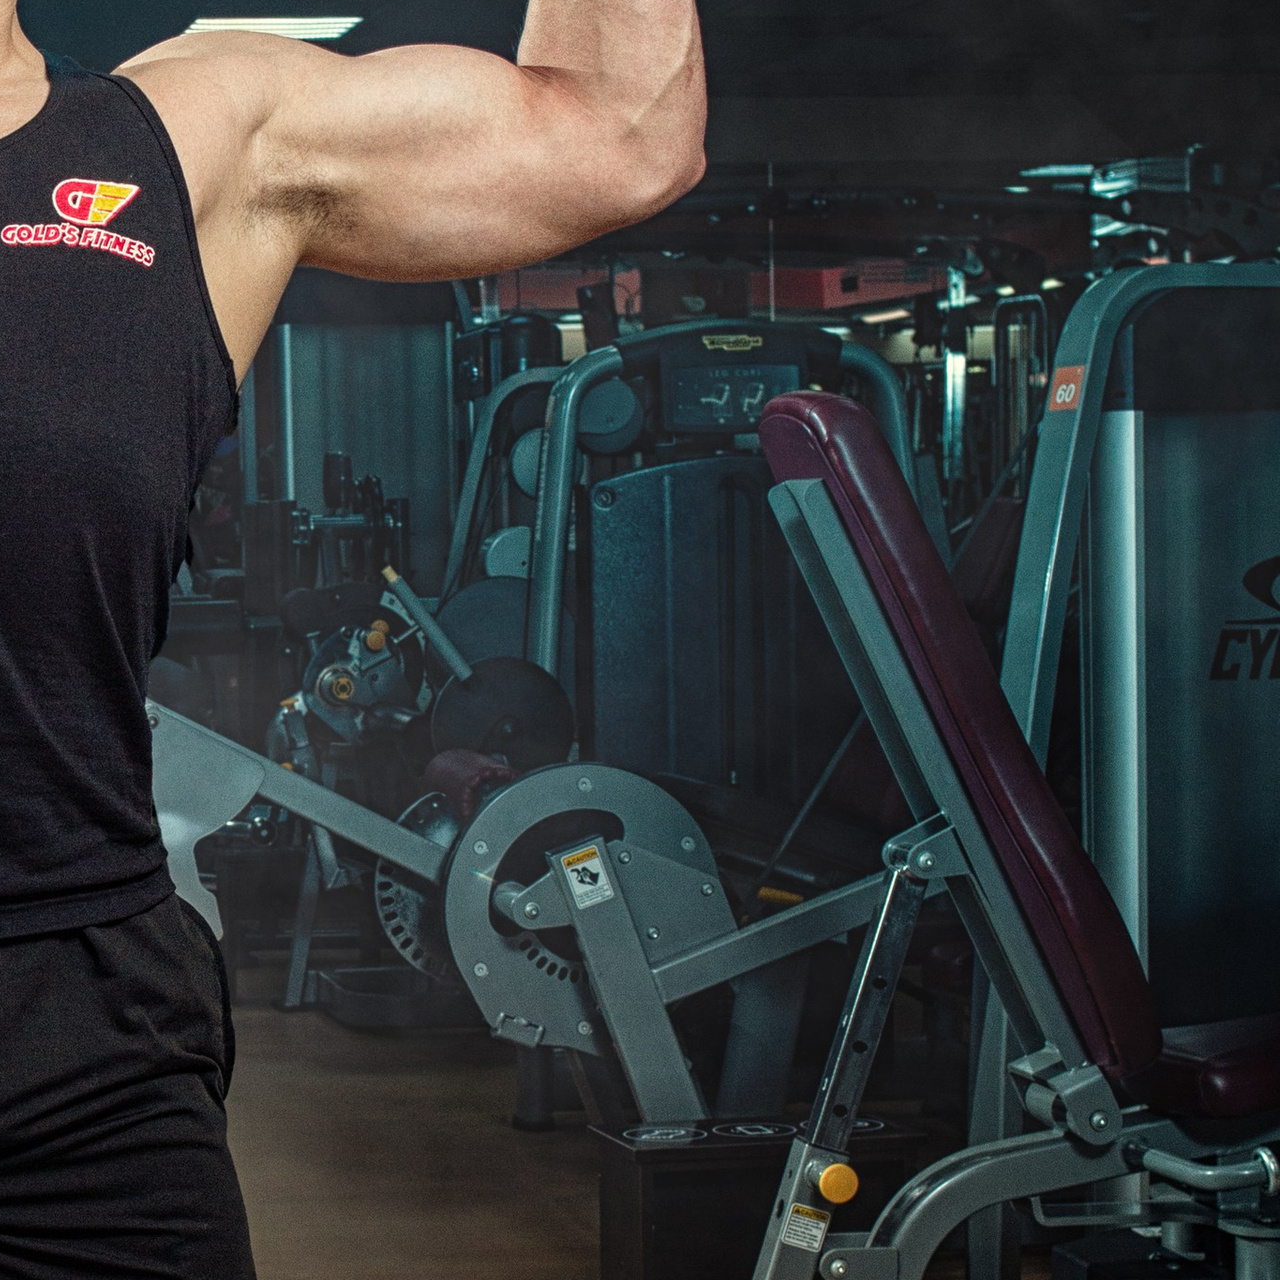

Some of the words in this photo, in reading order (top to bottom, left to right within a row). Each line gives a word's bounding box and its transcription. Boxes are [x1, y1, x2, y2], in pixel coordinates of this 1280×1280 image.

[1, 223, 80, 246] GOLD'S
[79, 227, 156, 268] FITNESS
[1056, 383, 1076, 404] 60
[1209, 628, 1280, 680] CY
